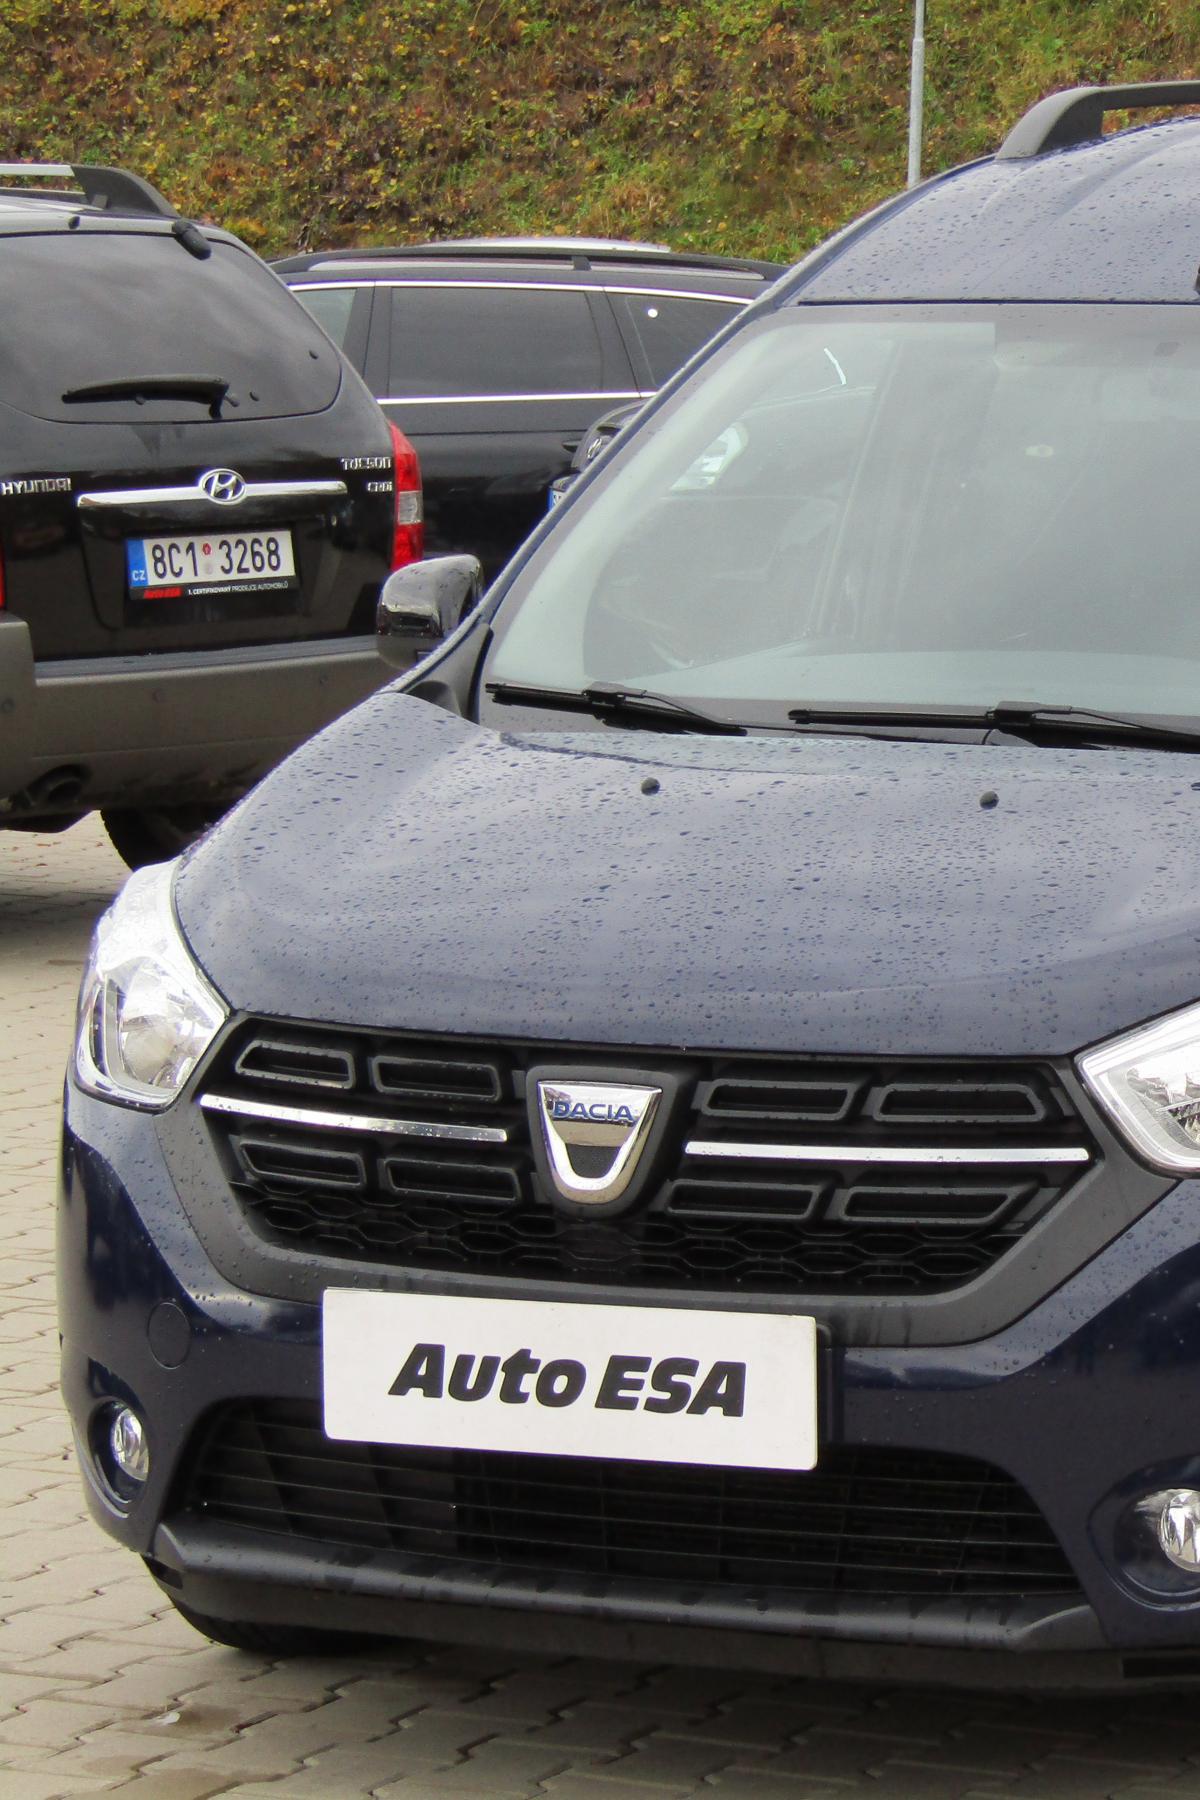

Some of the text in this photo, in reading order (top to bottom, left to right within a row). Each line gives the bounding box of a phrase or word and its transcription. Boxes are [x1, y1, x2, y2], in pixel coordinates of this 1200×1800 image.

[341, 456, 391, 470] TUCSON
[1, 478, 72, 495] HYUNDAI
[152, 537, 281, 579] 8C1 3268
[132, 570, 146, 581] CZ
[553, 1101, 635, 1121] DACIA
[388, 1342, 747, 1417] Auto ESA
